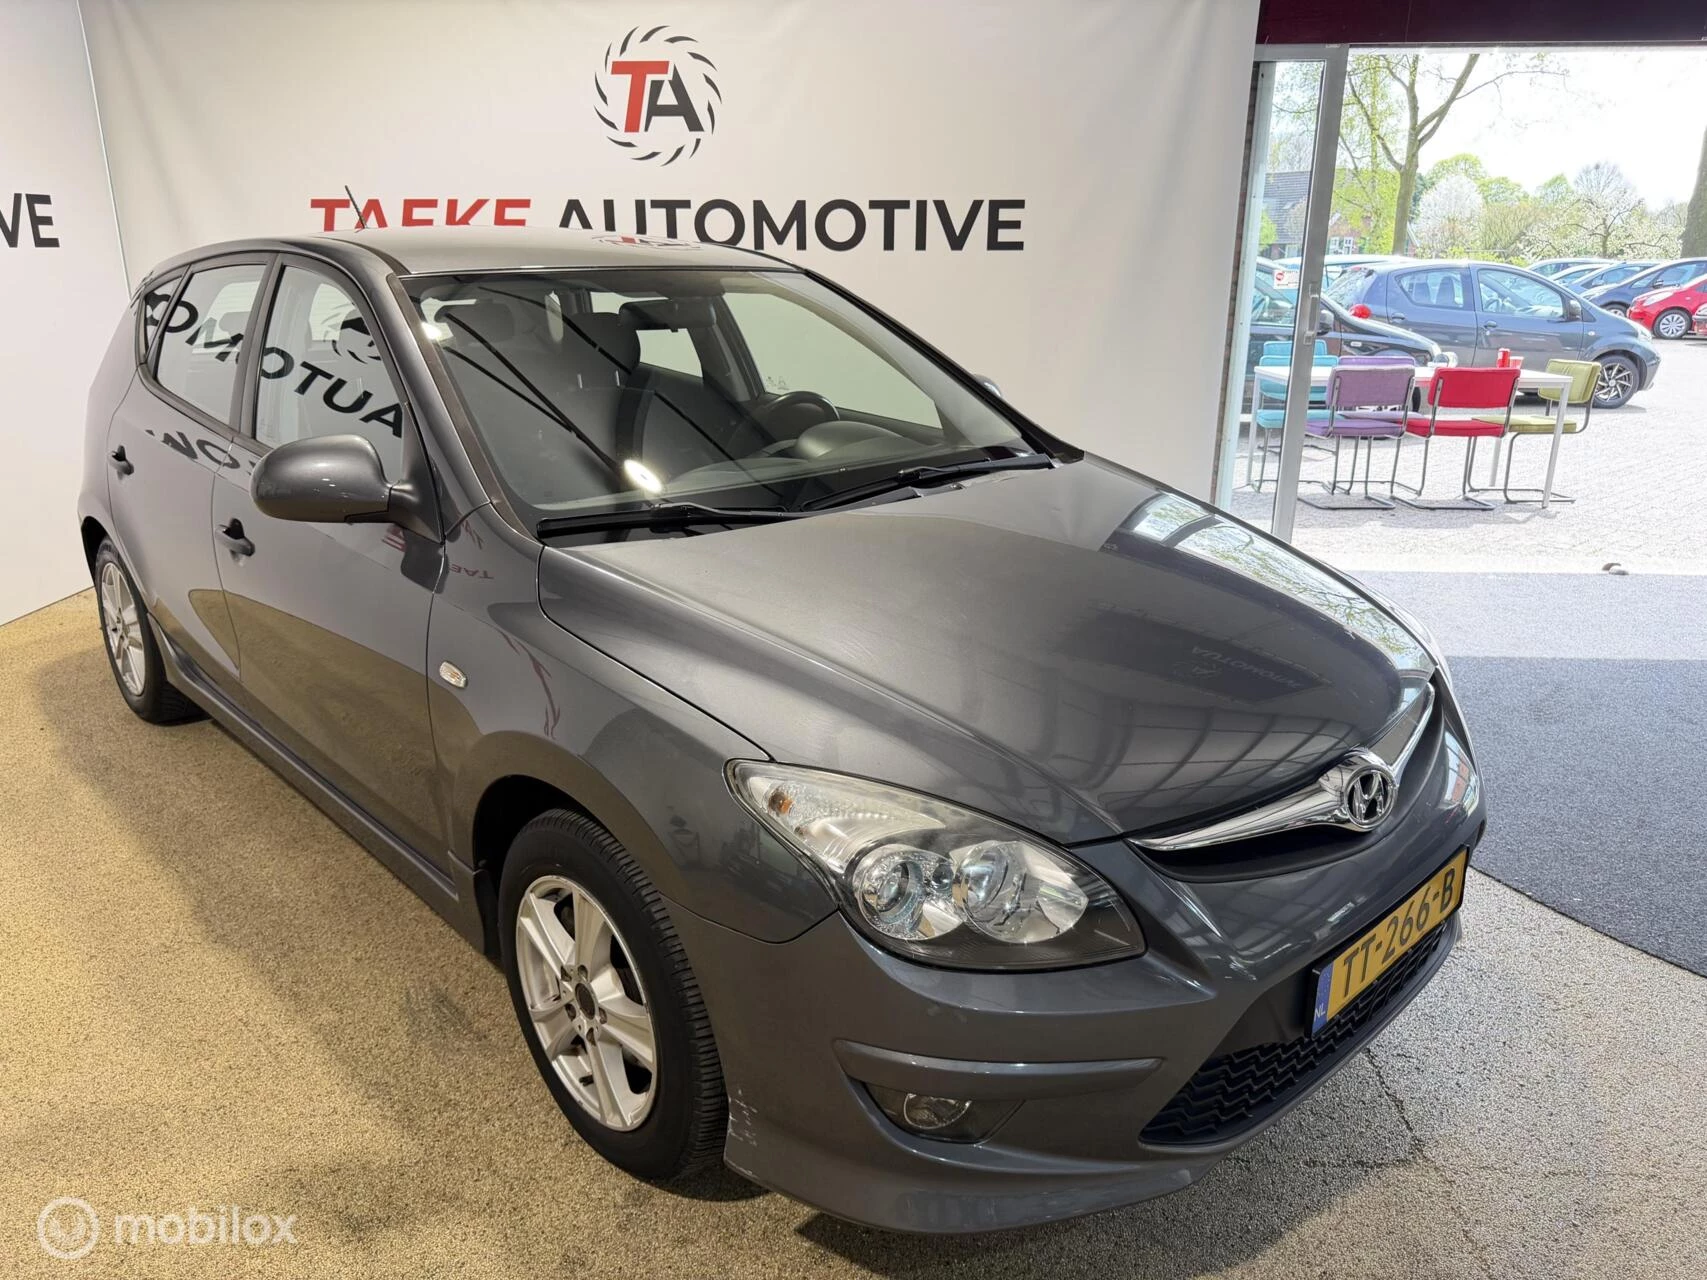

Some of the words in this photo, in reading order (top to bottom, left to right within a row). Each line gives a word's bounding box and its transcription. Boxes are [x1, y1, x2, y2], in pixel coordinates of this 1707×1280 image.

[610, 60, 705, 133] TA
[558, 198, 1026, 252] AUTOMOTIVE
[1342, 867, 1456, 999] TT-266-B
[1314, 1003, 1327, 1020] NL
